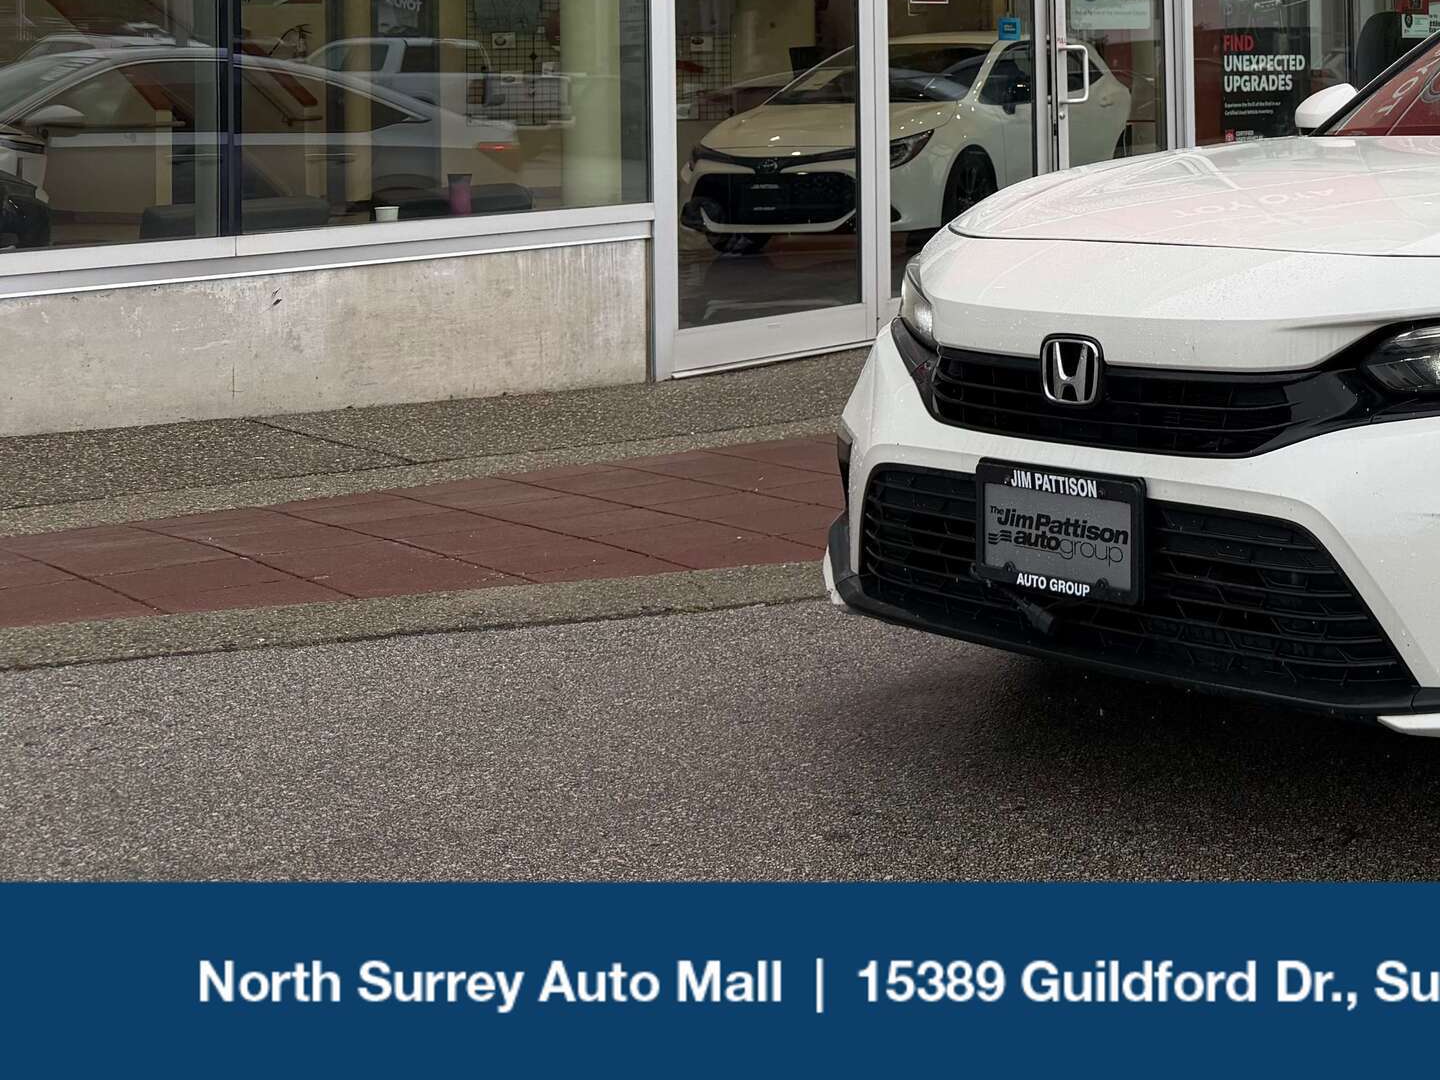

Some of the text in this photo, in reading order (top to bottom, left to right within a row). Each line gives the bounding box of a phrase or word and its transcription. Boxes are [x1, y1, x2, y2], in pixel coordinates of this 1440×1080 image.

[1224, 34, 1255, 52] FIND
[1224, 54, 1306, 72] UNEXPECTED
[1224, 74, 1293, 93] UPGRADES
[1011, 470, 1098, 499] JIM PATTISON
[1016, 572, 1090, 598] AUTO GROUP
